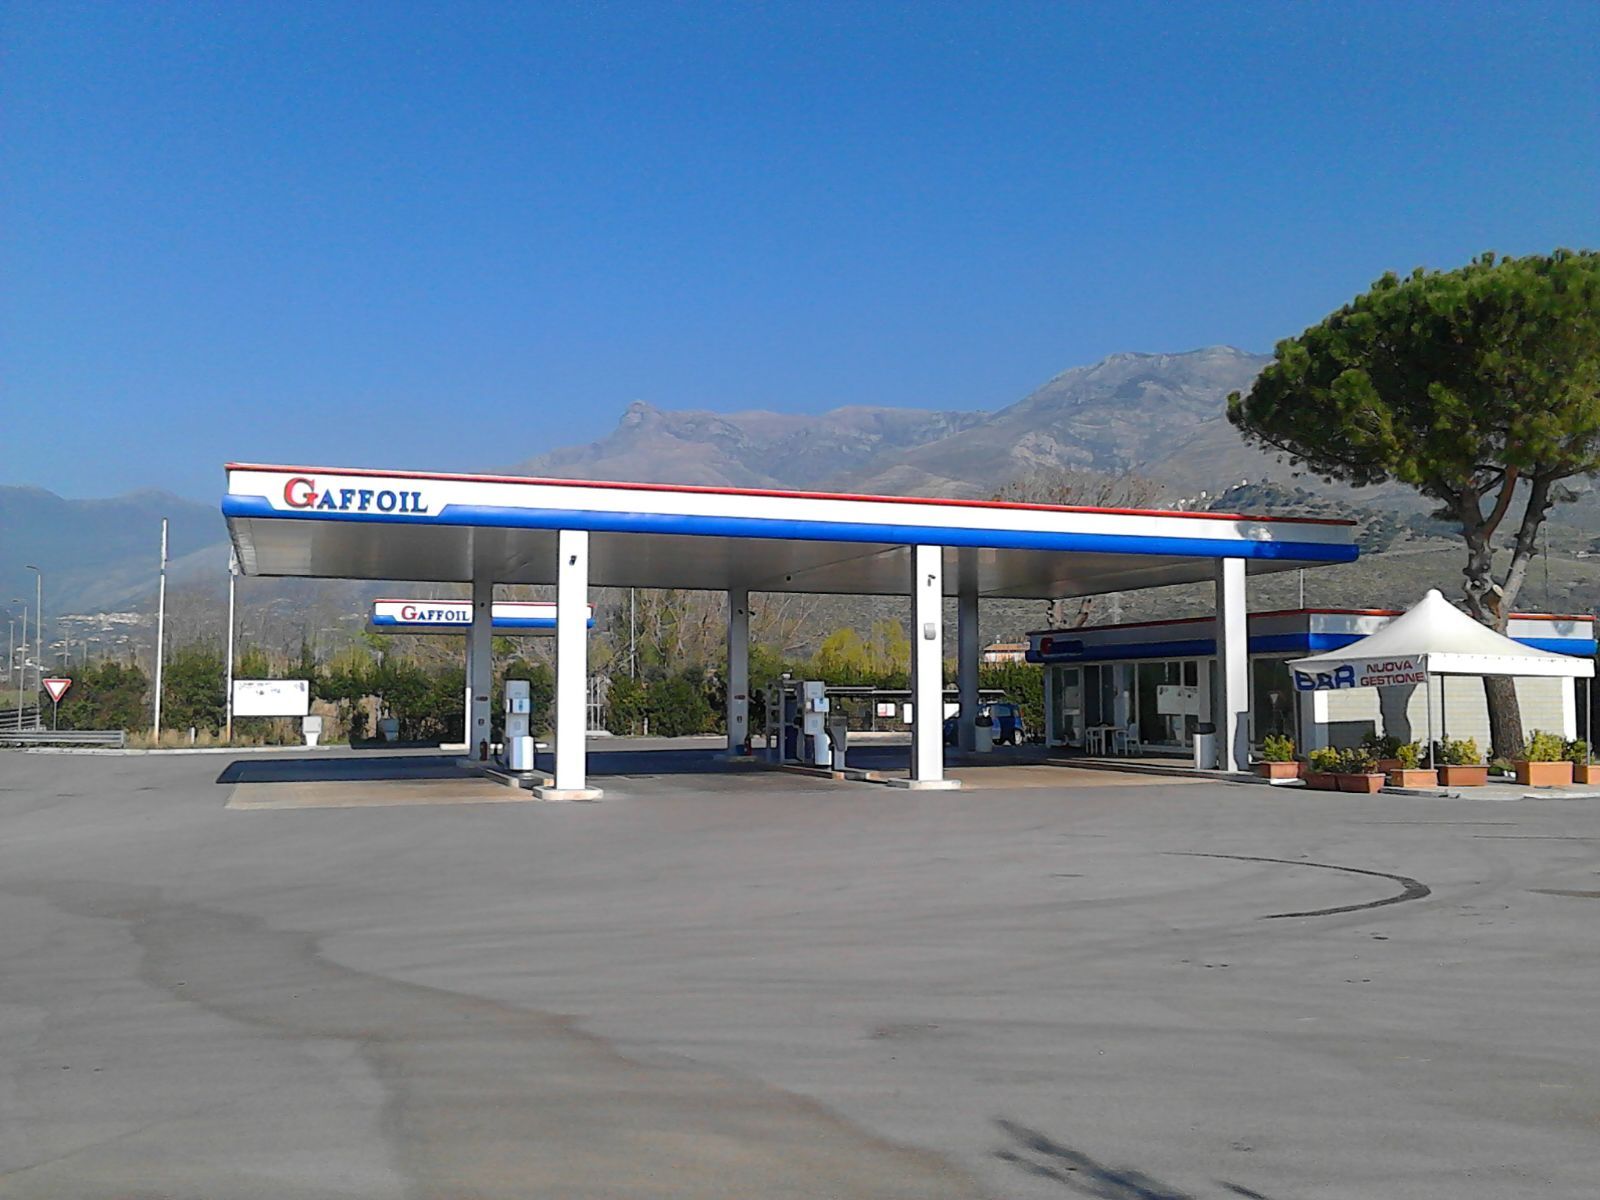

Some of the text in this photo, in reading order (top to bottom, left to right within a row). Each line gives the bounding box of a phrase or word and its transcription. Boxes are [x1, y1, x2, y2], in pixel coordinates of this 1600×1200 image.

[284, 477, 428, 513] GAFFOIL
[401, 605, 470, 621] GAFFOIL
[1366, 660, 1413, 673] NUOVA
[1294, 665, 1355, 690] BAR
[1360, 672, 1425, 686] GESTIONE
